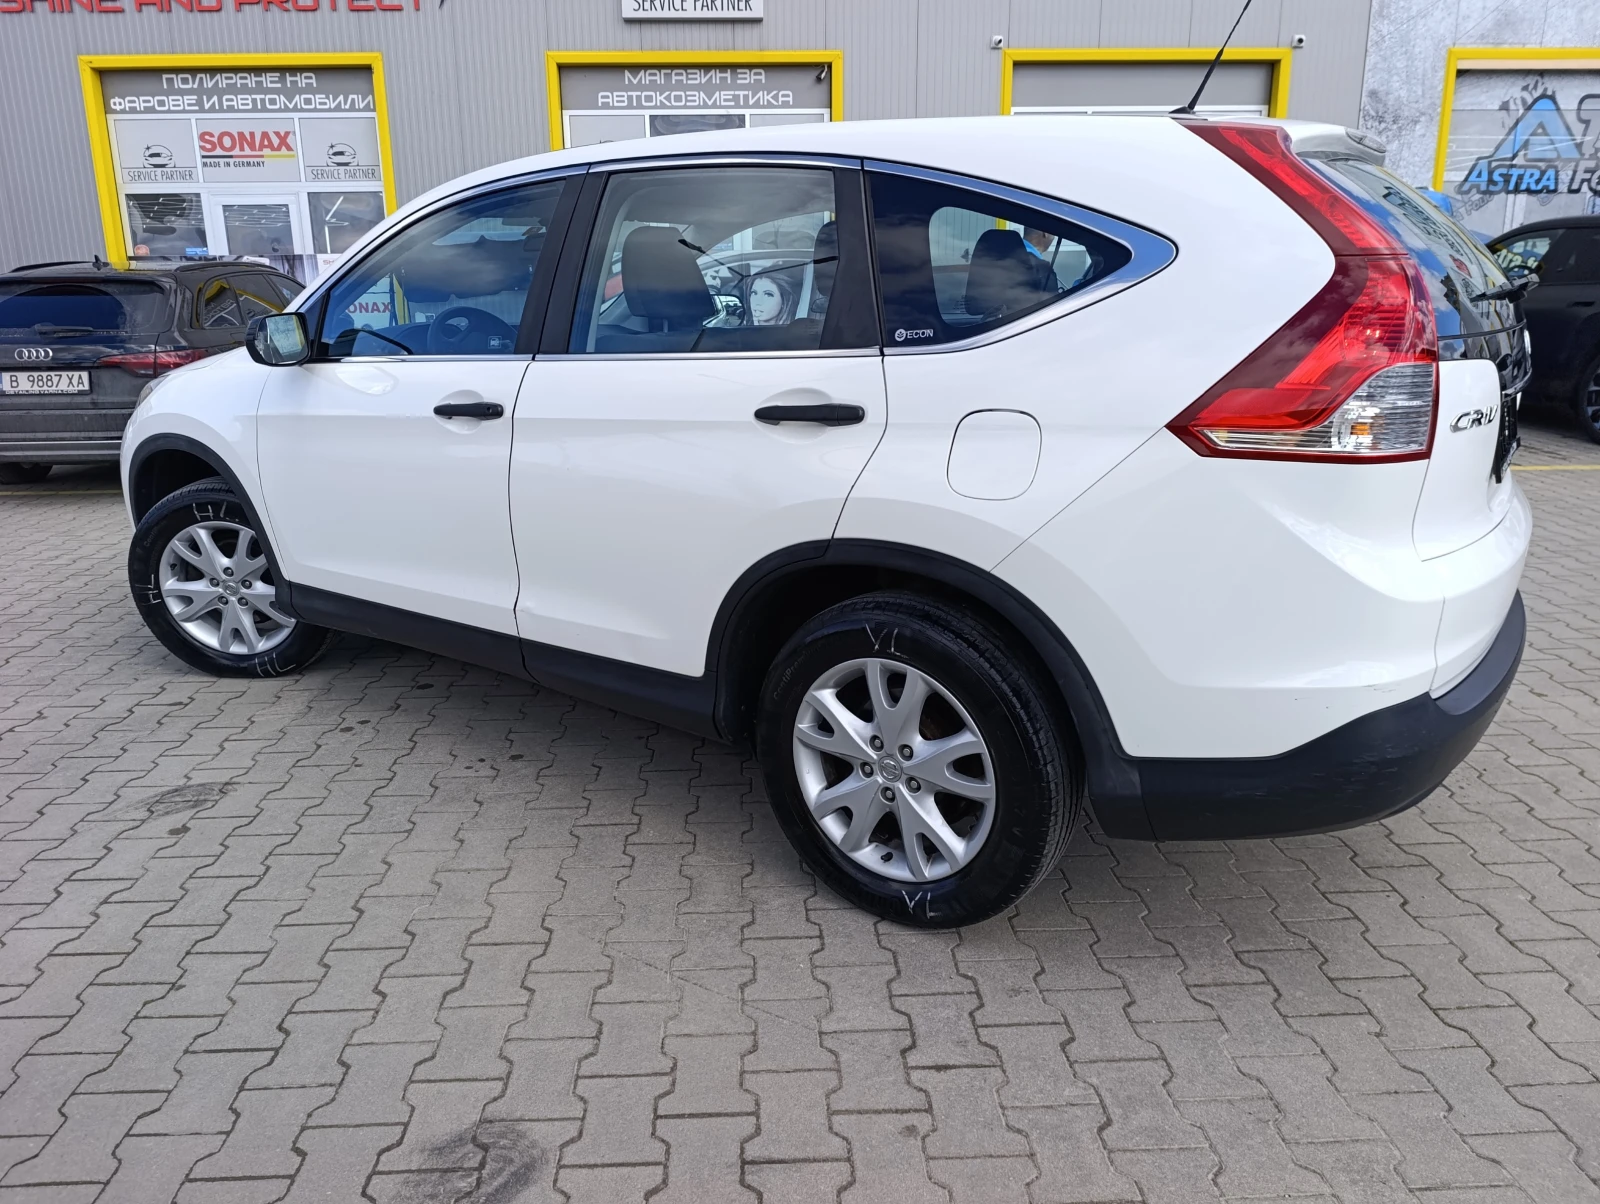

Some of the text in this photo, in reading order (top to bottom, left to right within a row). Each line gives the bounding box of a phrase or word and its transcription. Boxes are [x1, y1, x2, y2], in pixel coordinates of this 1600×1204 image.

[633, 0, 753, 12] SERVICE PARTNER
[162, 73, 316, 89] ПОЛИРАНЕ НА
[624, 69, 765, 84] МАГАЗИН ЗА
[110, 94, 374, 111] ФАРОВЕ И АВТОМОБИЛИ
[598, 91, 793, 106] АВТОКОЗМЕТИКА
[199, 131, 294, 153] SONAX
[203, 160, 265, 168] MADE IN GERMANY
[127, 169, 194, 182] SERVICE PARTNER
[311, 168, 376, 180] SERVICE PARTNER
[1458, 160, 1558, 193] ASTRA
[907, 328, 934, 339] ECON
[9, 373, 85, 389] B 9887 XA
